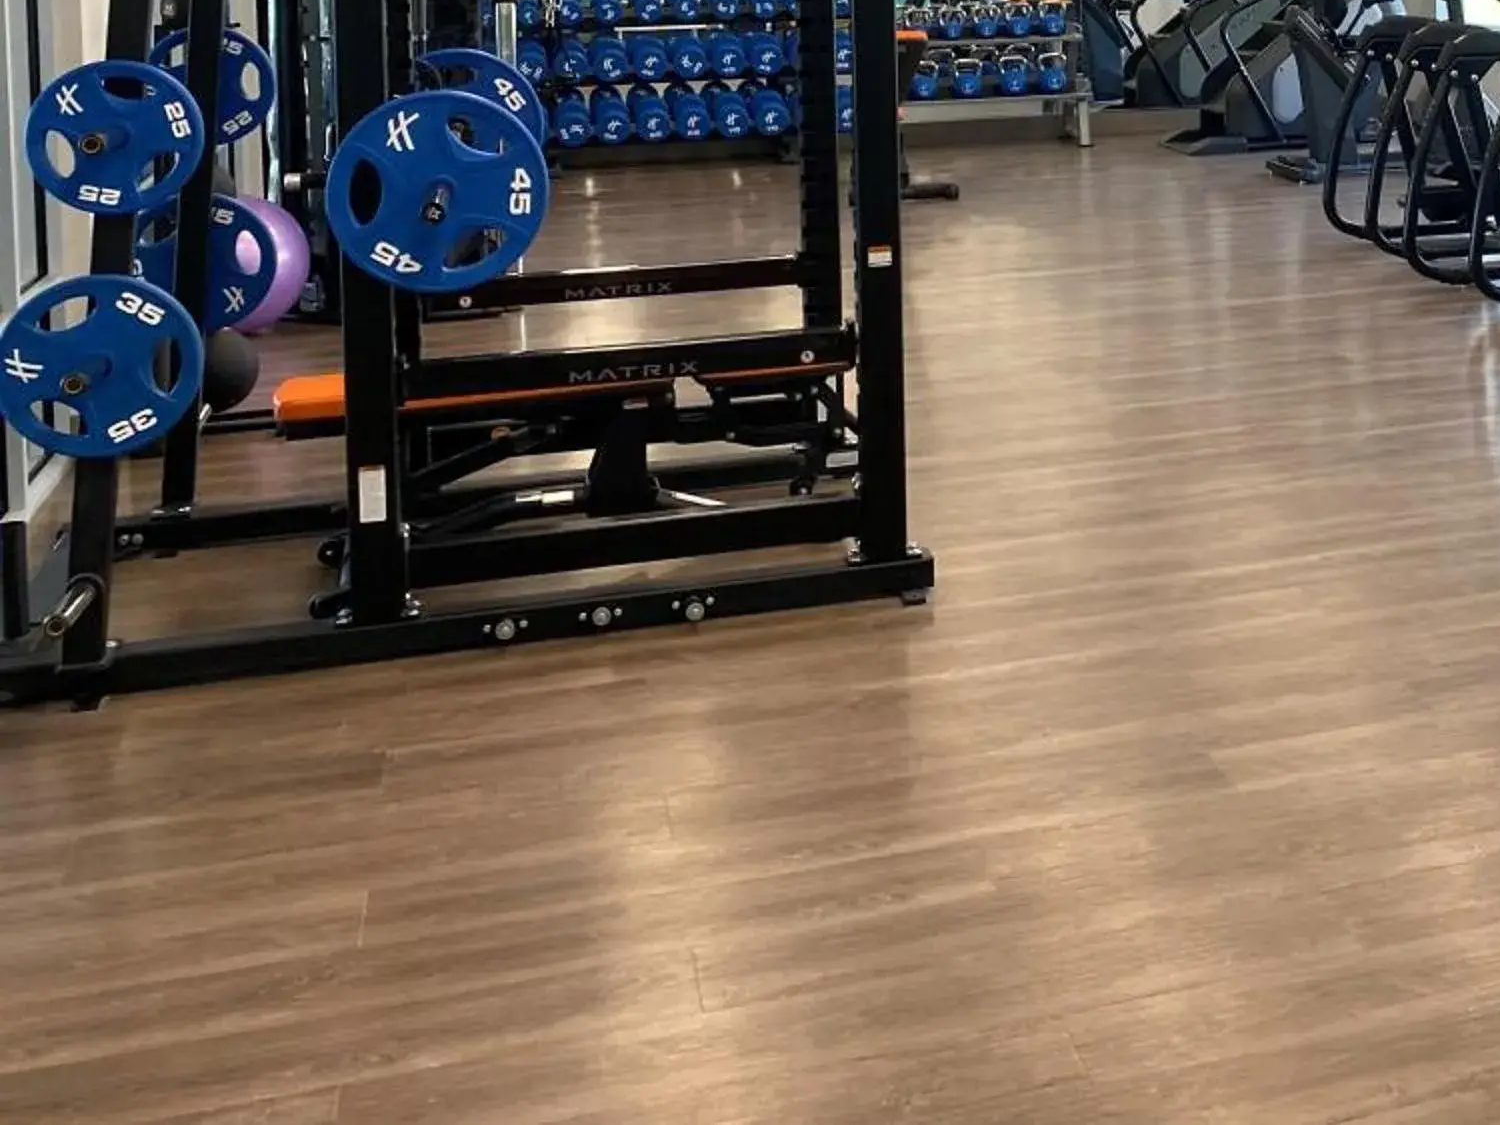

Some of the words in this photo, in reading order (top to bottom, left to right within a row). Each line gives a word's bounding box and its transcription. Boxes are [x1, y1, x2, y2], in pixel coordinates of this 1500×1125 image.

[493, 77, 527, 113] 45
[163, 101, 192, 139] 25
[221, 110, 253, 135] 25
[77, 184, 121, 206] 25
[509, 167, 532, 216] 45
[369, 240, 424, 273] 45
[564, 281, 673, 300] MATRIX
[114, 291, 167, 326] 35
[568, 360, 698, 384] MATRIX
[107, 407, 158, 444] 35
